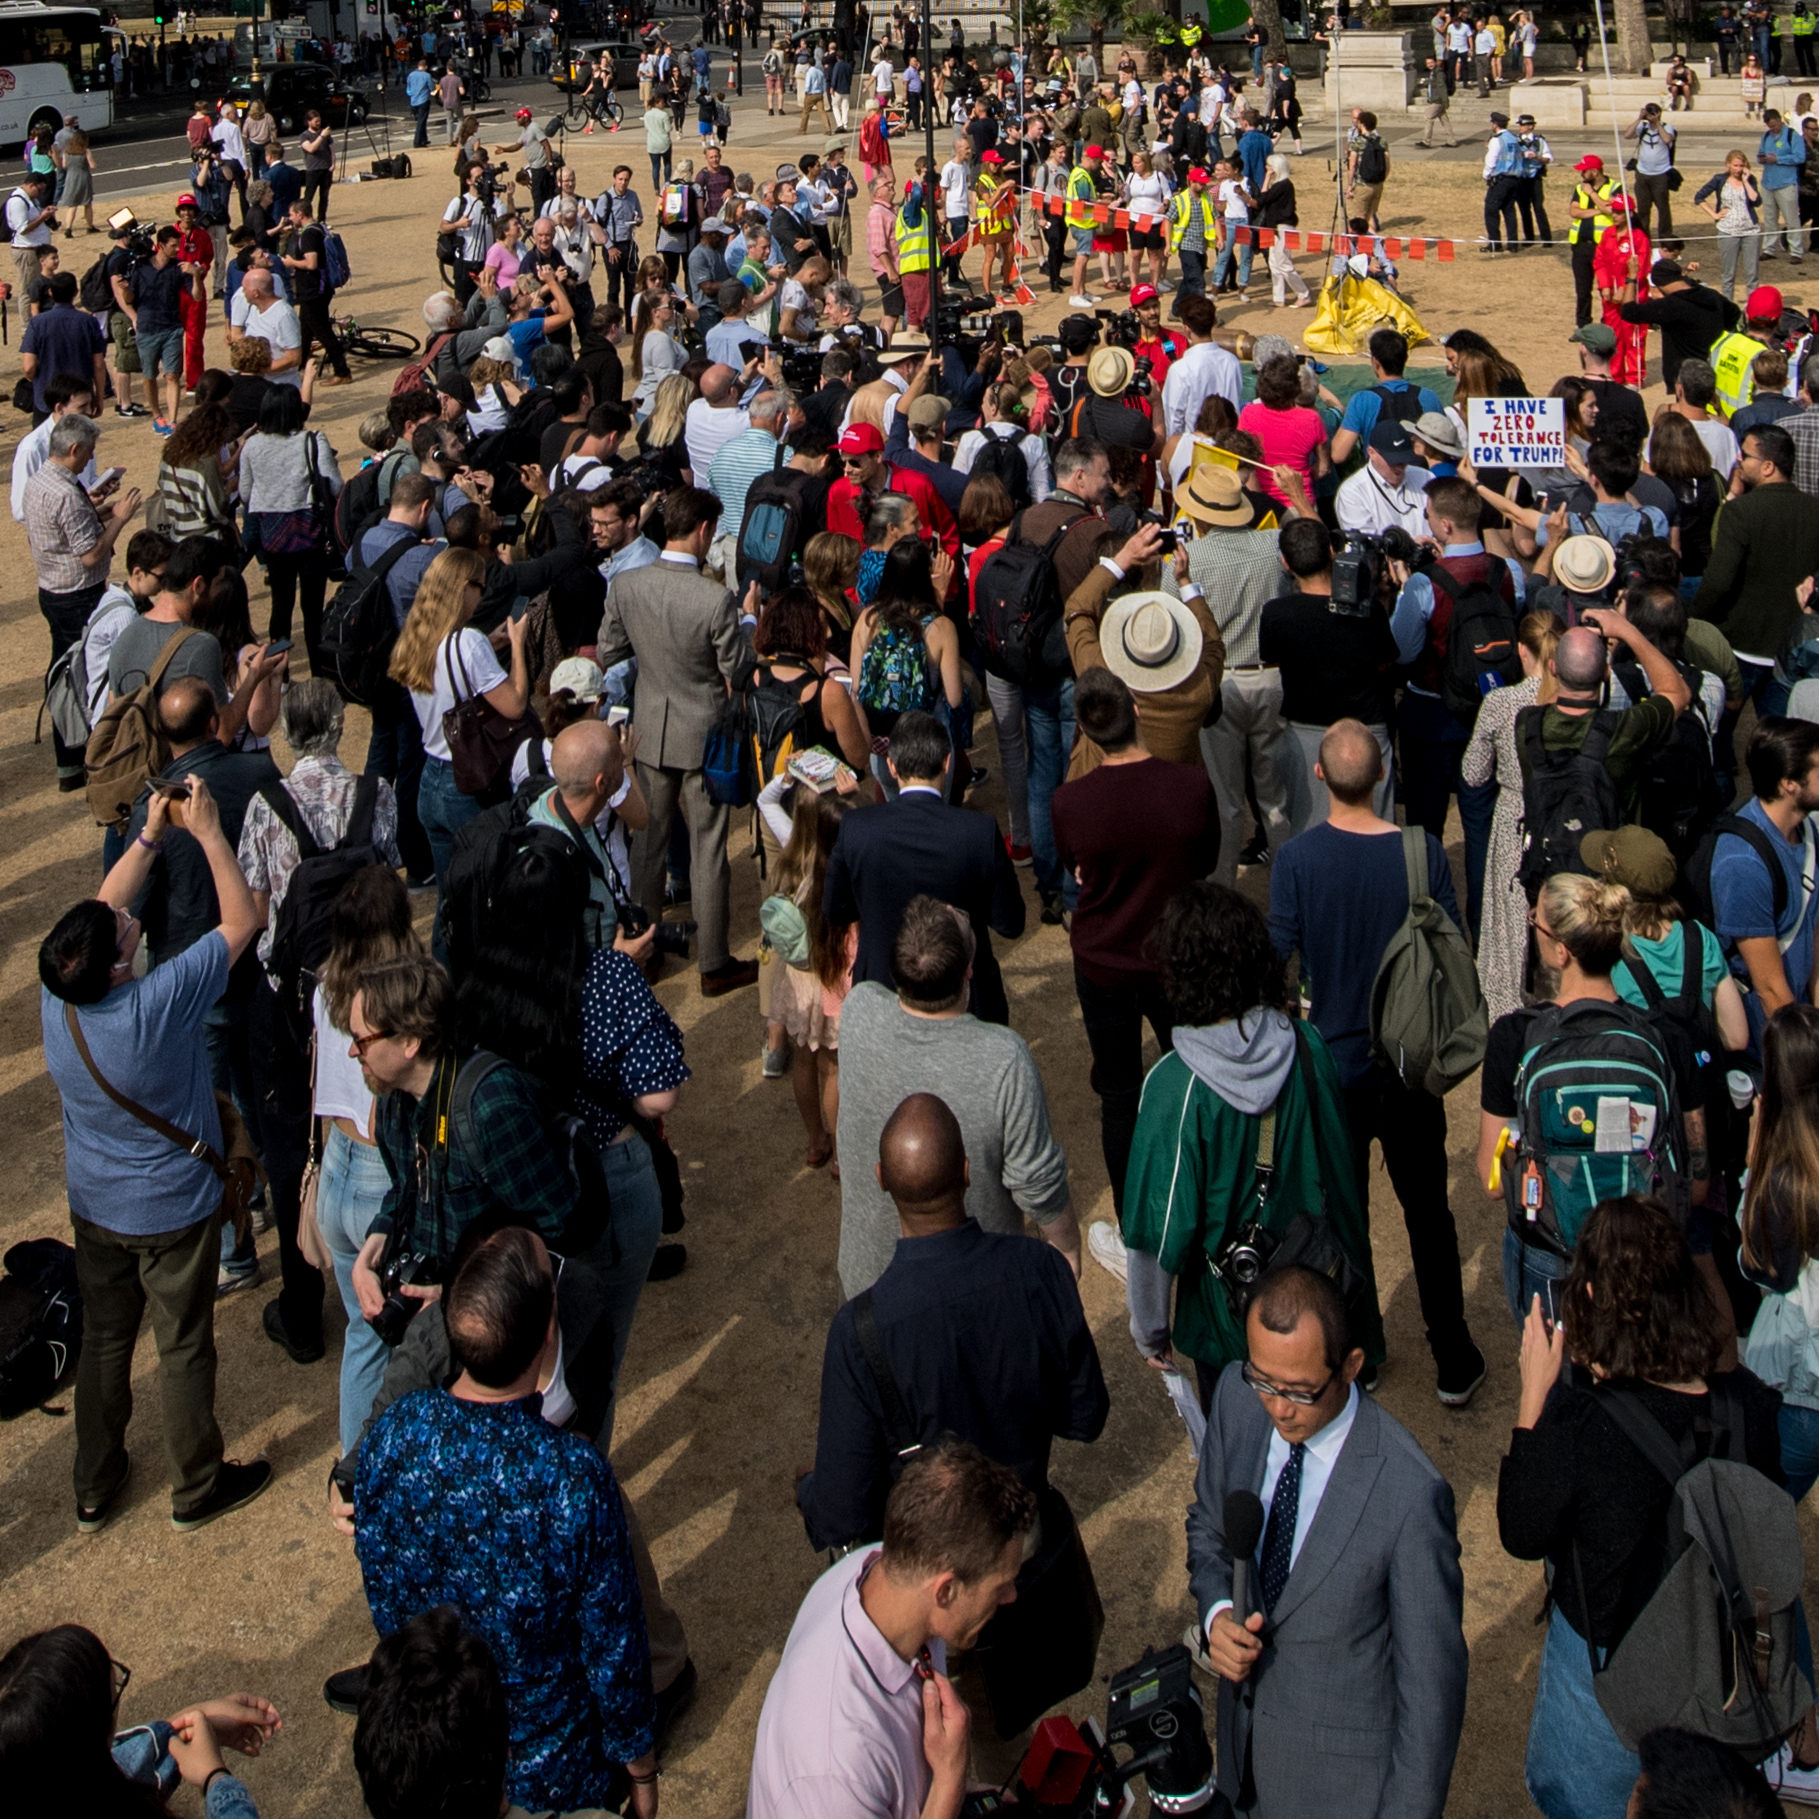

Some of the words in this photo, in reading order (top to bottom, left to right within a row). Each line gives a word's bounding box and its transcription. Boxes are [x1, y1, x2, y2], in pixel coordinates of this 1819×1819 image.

[1484, 400, 1496, 414] I
[1504, 400, 1547, 415] HAVE
[1493, 414, 1535, 431] ZERO
[1479, 431, 1562, 445] TOLERANCE
[1474, 446, 1503, 463] FOR
[1509, 446, 1563, 463] TRUMP!
[438, 1114, 446, 1144] Nikon
